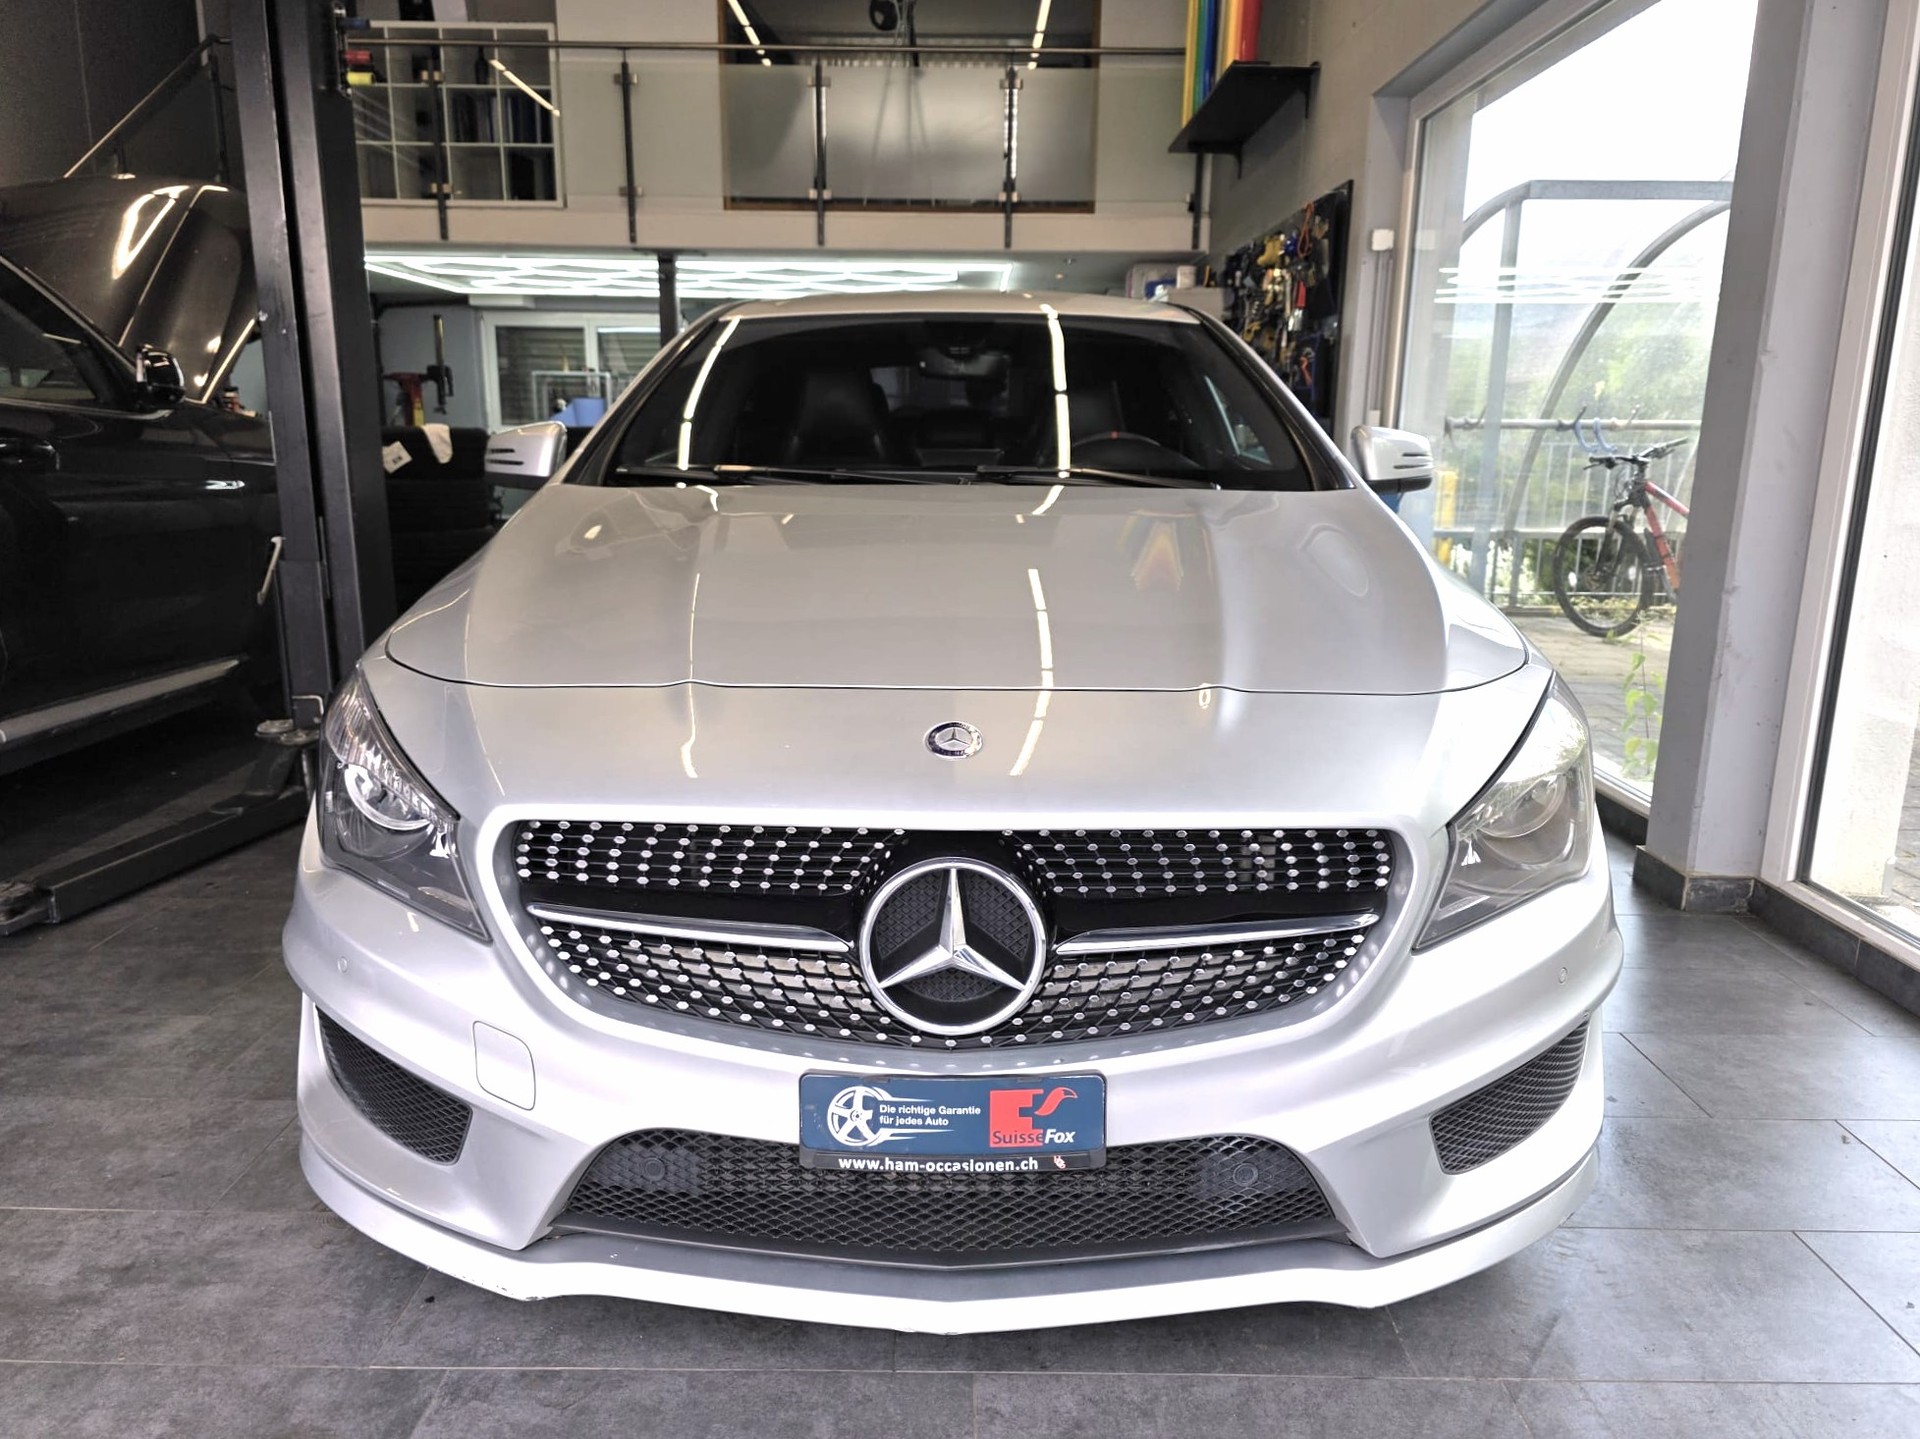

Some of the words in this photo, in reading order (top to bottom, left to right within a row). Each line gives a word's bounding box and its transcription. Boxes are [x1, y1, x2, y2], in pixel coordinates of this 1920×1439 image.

[879, 1104, 896, 1114] Die
[898, 1105, 936, 1116] richtige
[938, 1106, 981, 1115] Garantie
[879, 1116, 894, 1125] für
[895, 1116, 923, 1126] jedes
[924, 1117, 949, 1126] Auto
[838, 1157, 1039, 1172] www.ham-occasionen.ch
